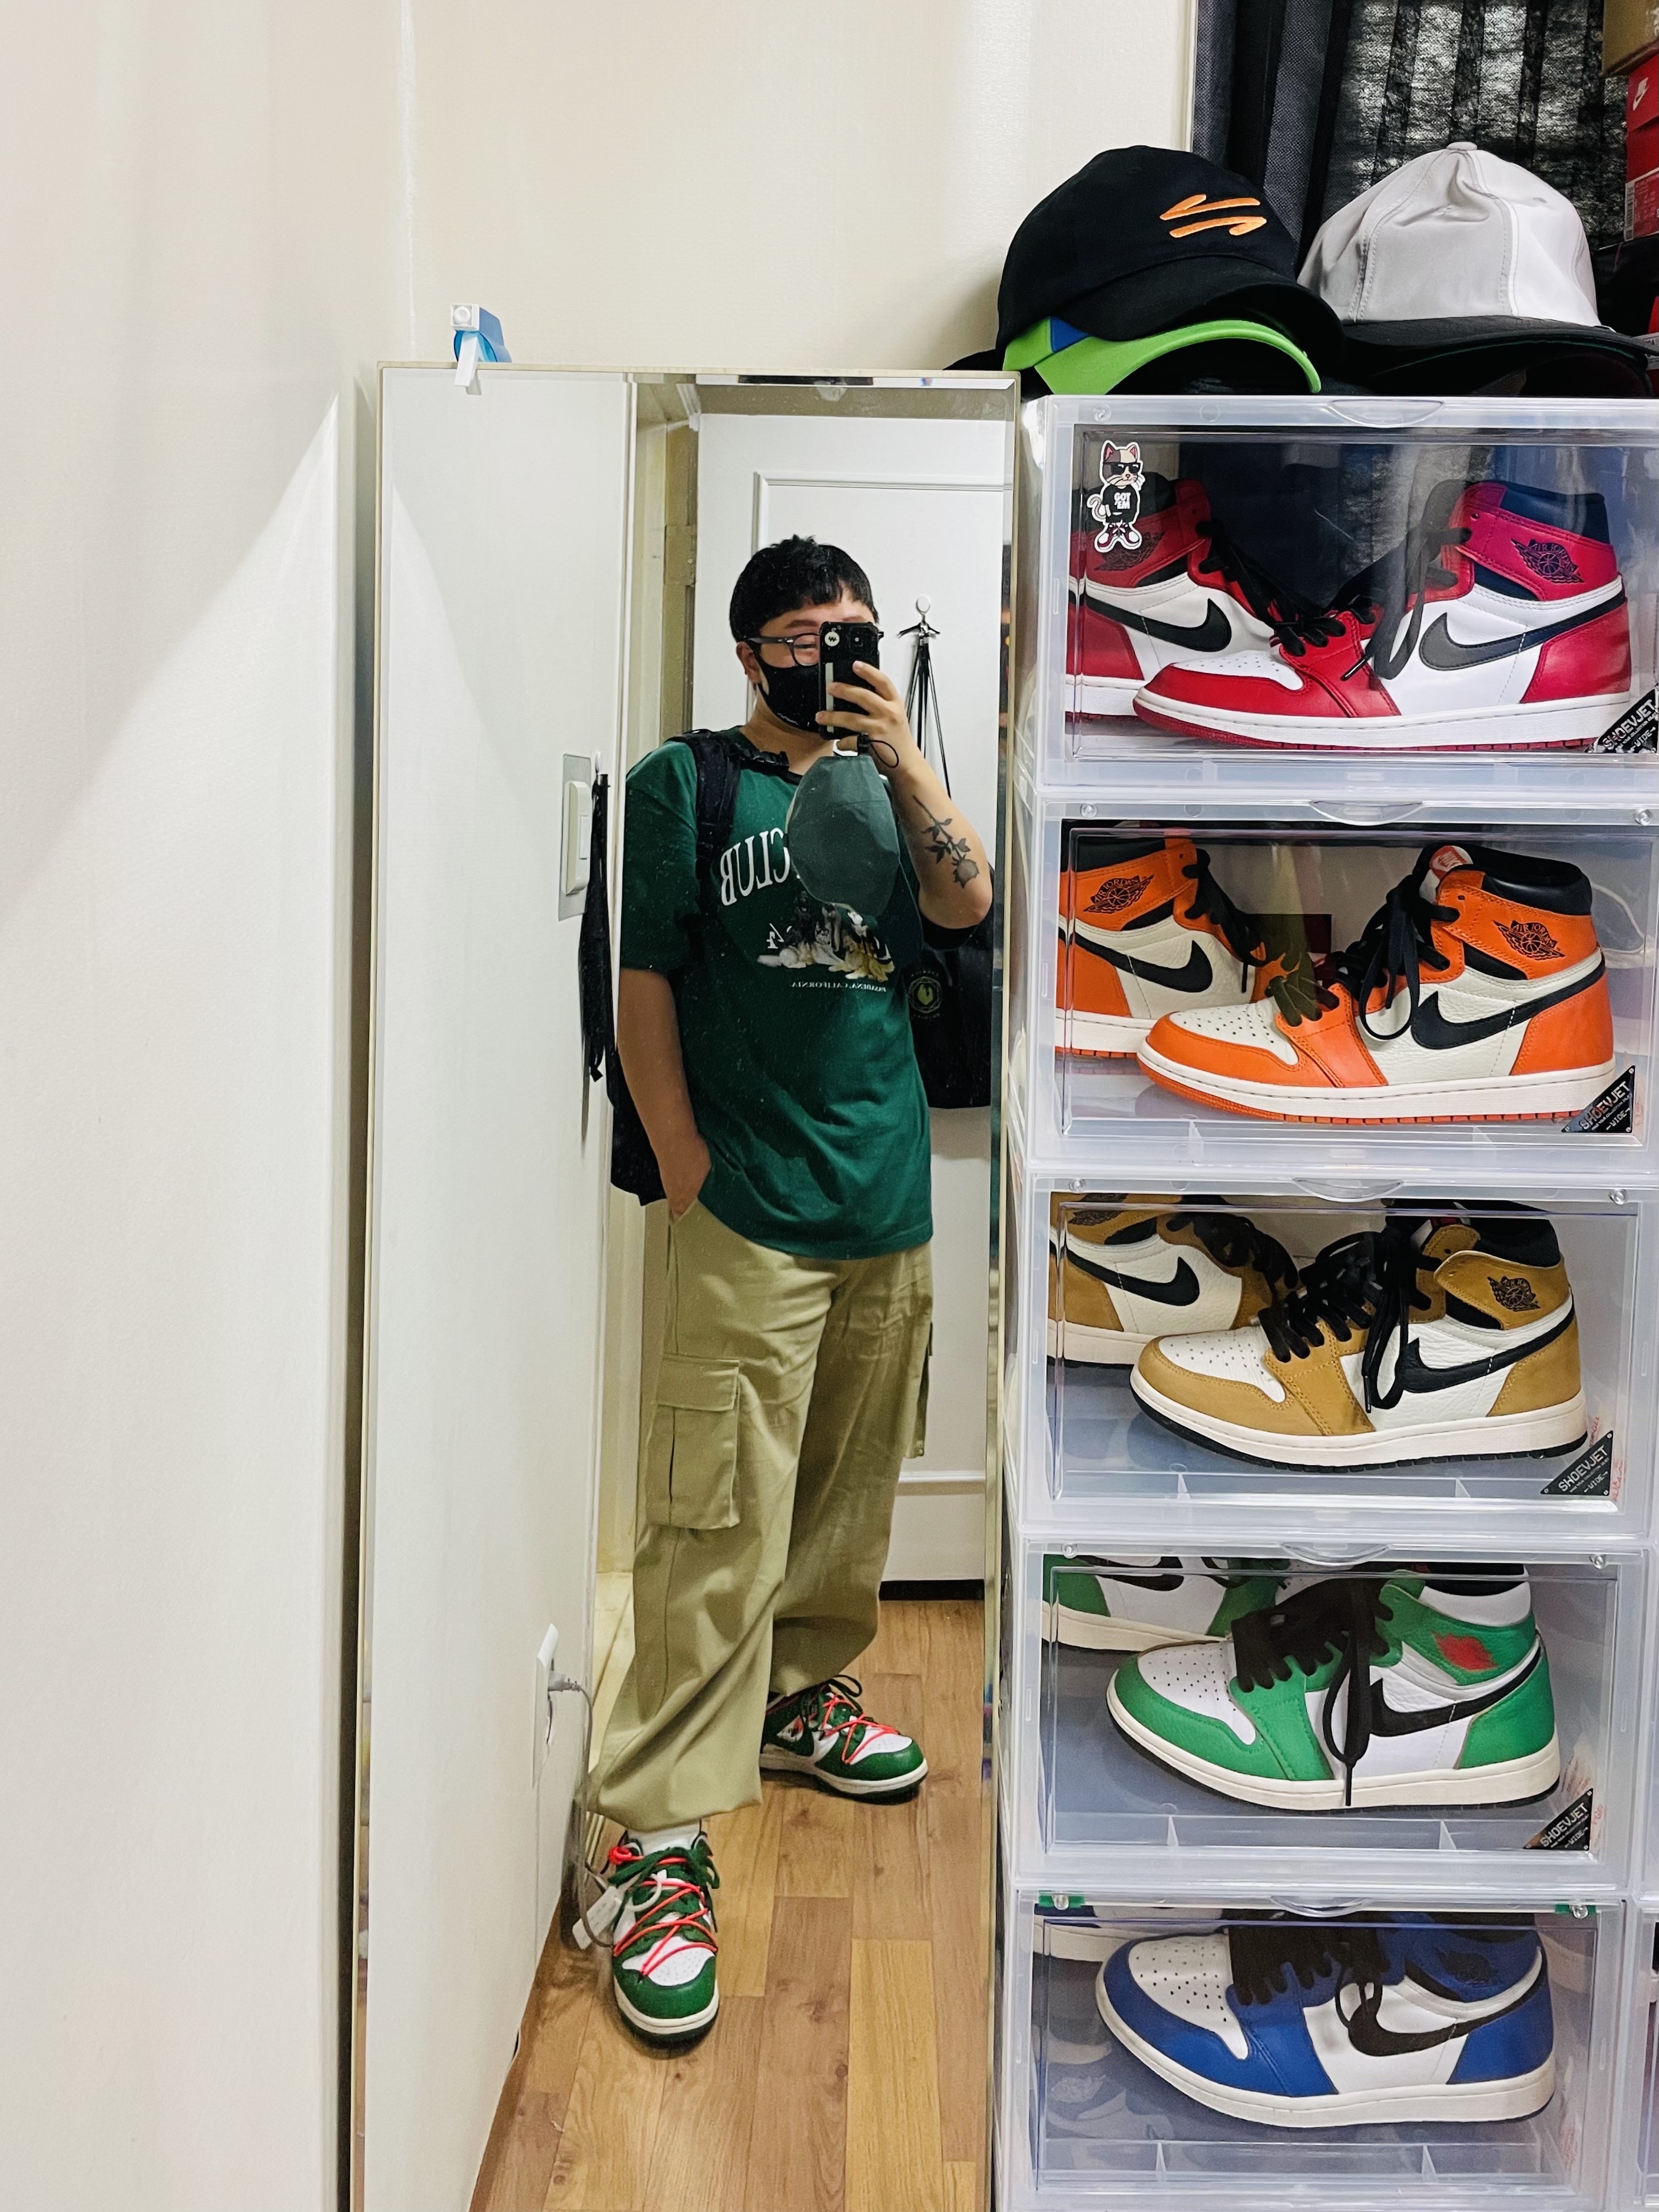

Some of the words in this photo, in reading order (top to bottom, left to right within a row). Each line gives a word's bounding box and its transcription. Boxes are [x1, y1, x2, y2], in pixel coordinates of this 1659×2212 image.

[1114, 492, 1131, 501] GOT
[1531, 543, 1548, 552] AIR
[1634, 730, 1653, 747] WIDE
[1094, 890, 1107, 903] AIR
[1102, 877, 1138, 890] JORDAN
[1512, 924, 1529, 932] AIR
[1531, 923, 1555, 948] JORDAN
[1579, 1081, 1630, 1130] SHOEVJET
[1610, 1111, 1627, 1127] WIDE
[1558, 1444, 1608, 1492] SHOEVJET
[1587, 1473, 1605, 1490] WIDE
[1539, 1803, 1588, 1847] SHOEVJET
[1568, 1830, 1584, 1845] WIDE
